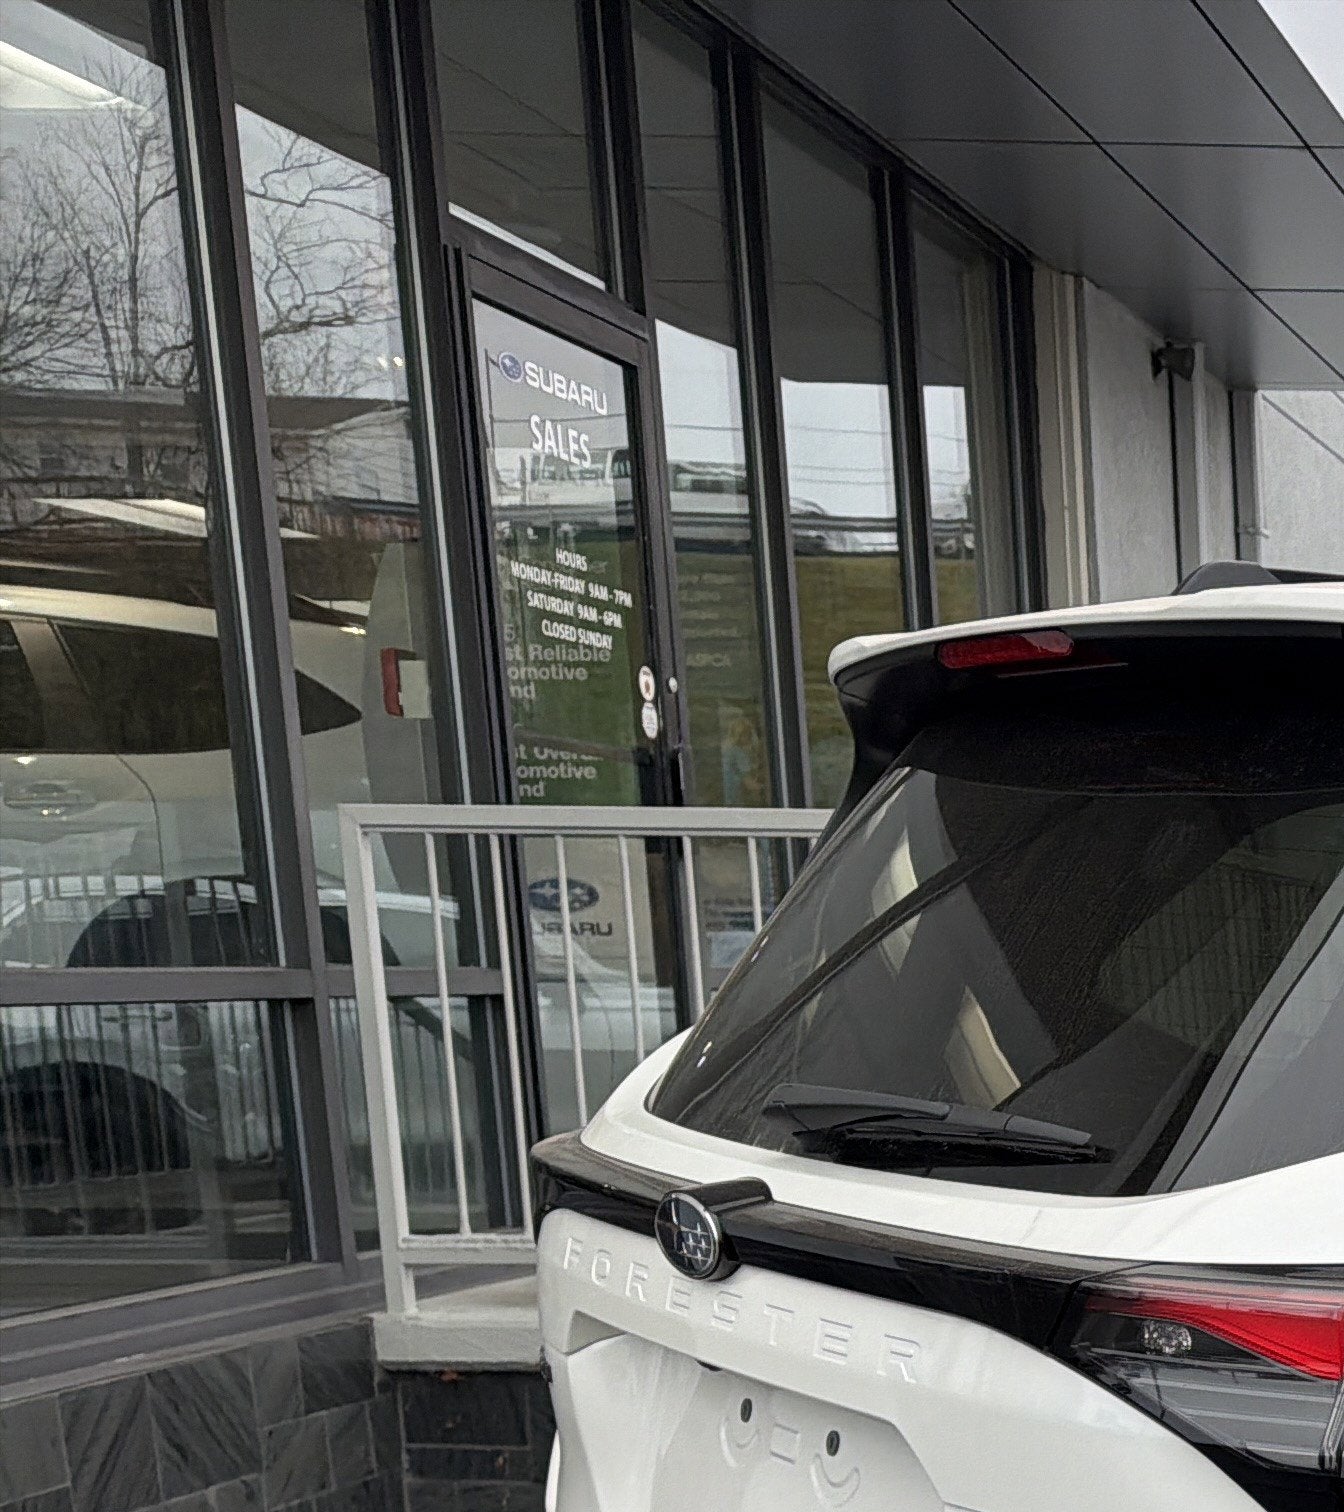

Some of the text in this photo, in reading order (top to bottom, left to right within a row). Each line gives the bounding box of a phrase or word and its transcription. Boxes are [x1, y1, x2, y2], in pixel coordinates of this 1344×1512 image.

[524, 361, 608, 416] SUBARU
[530, 414, 592, 469] SALES
[555, 547, 588, 572] HOURS
[526, 590, 575, 616] SATURDAY
[541, 618, 613, 650] CLOSED SUNDAY
[528, 643, 611, 662] Reliable
[562, 1236, 923, 1385] FORESTER
